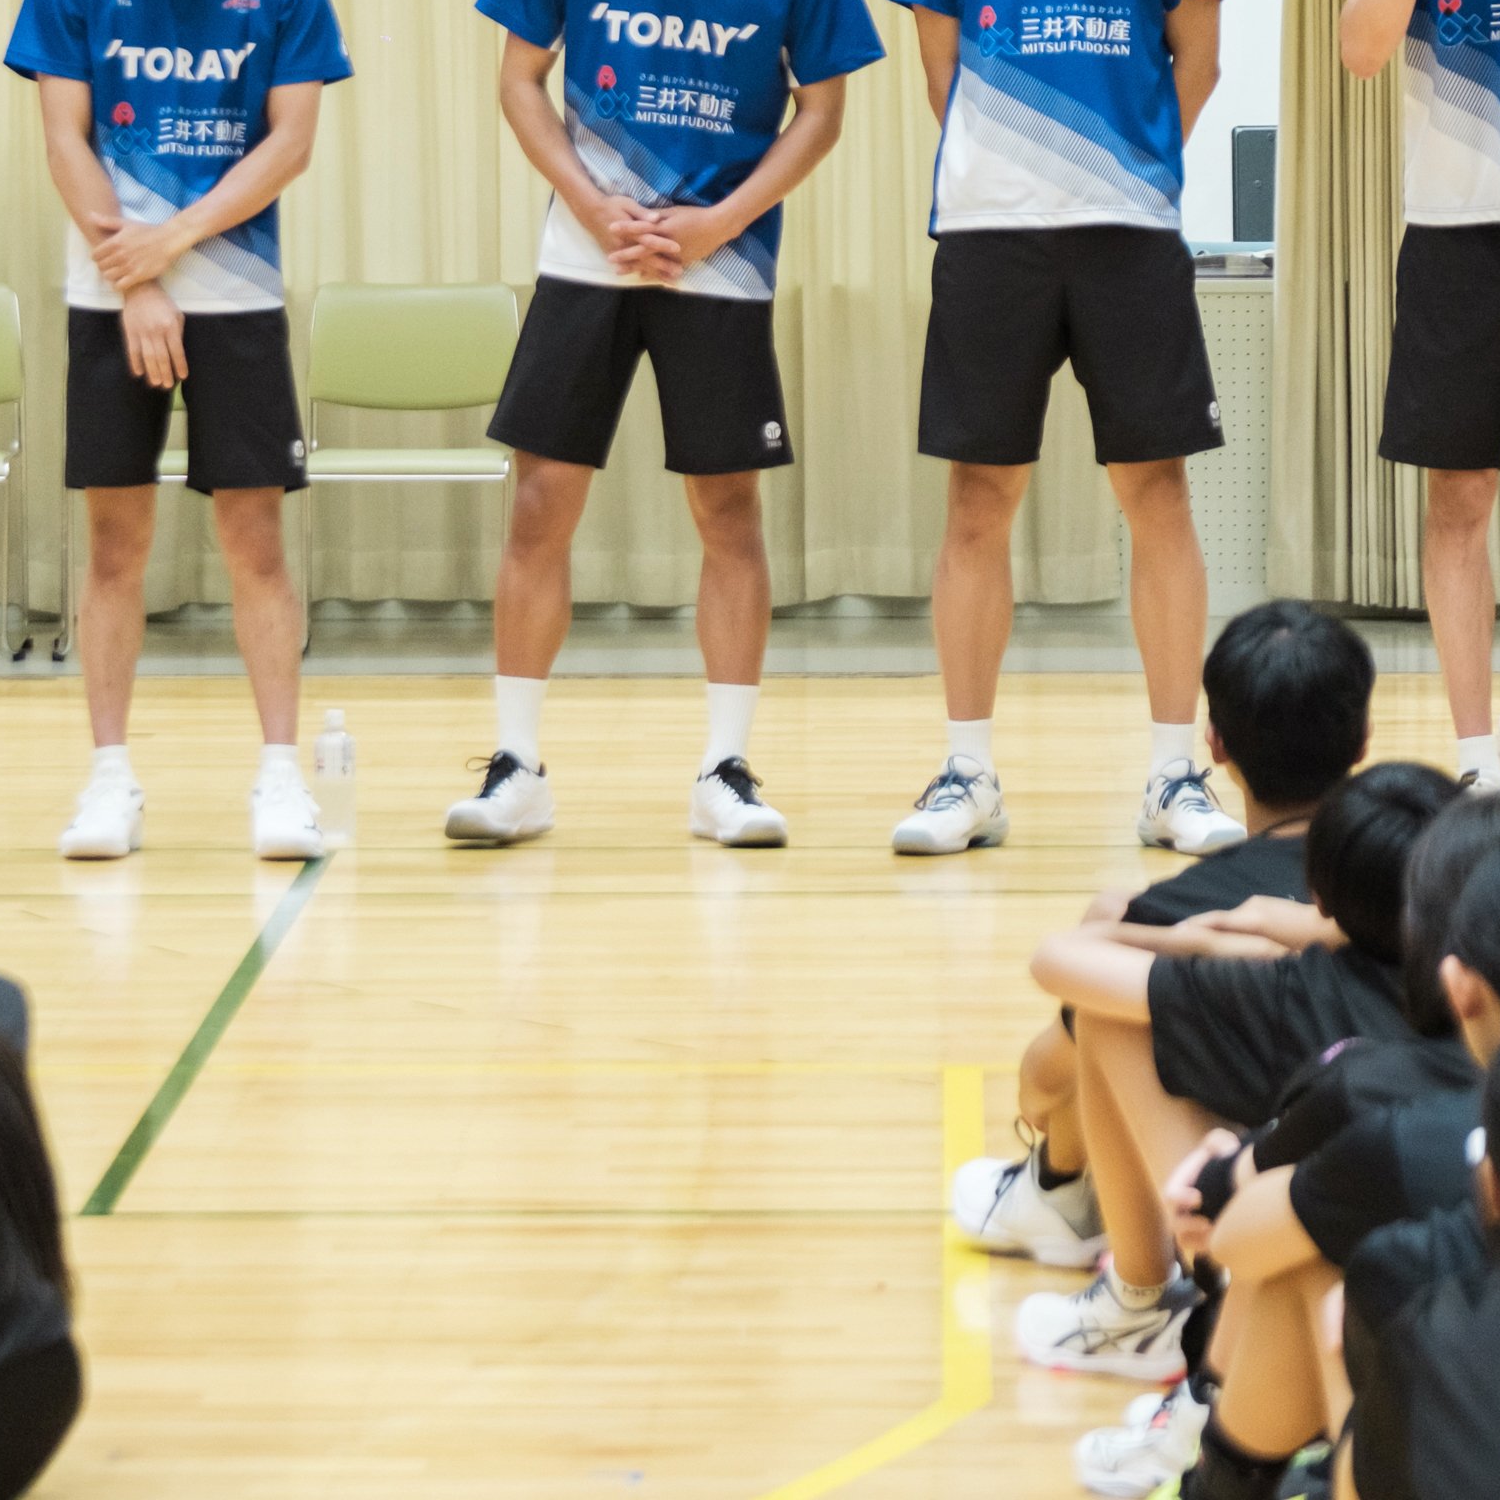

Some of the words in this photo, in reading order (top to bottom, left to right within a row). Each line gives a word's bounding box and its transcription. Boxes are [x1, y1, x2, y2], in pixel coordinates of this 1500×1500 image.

[1020, 15, 1132, 42] 三井不動産
[1020, 41, 1067, 55] MITSUI
[1068, 39, 1131, 57] FUDOSAN
[636, 85, 736, 121] 三井不動産
[157, 117, 248, 143] 三井不動産
[635, 110, 678, 126] MITSUI
